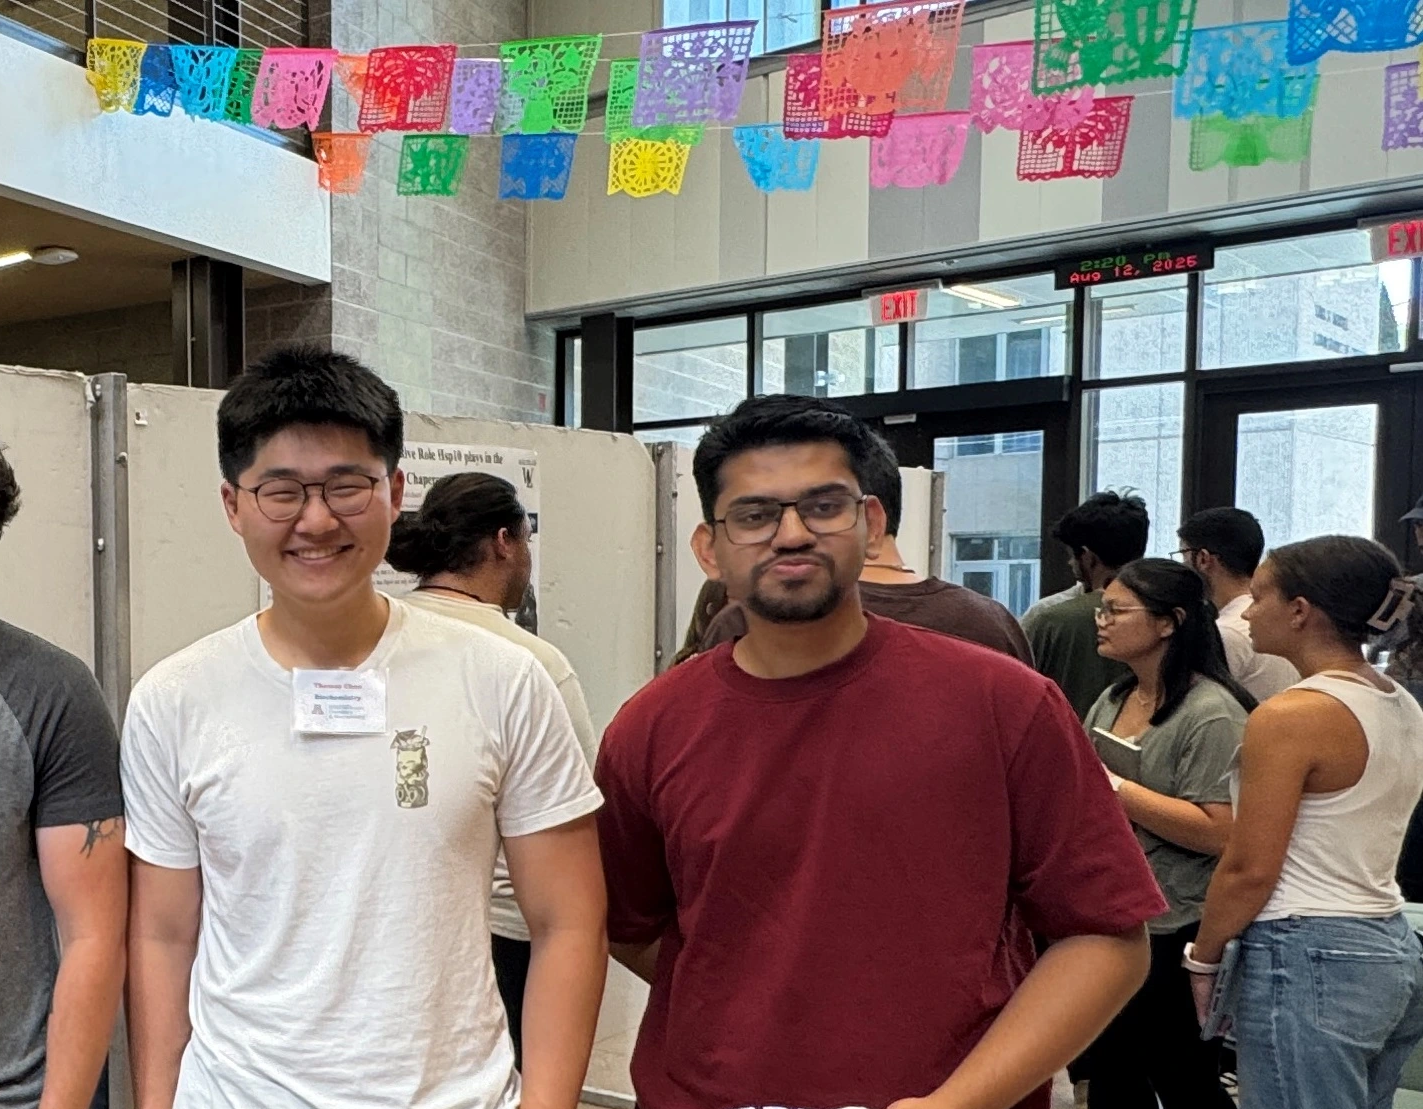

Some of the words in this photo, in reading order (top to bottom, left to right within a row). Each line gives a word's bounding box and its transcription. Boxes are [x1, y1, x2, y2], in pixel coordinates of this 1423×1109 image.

[1387, 220, 1423, 256] EXI
[1080, 254, 1127, 272] 2:20
[1070, 271, 1101, 284] Aug
[881, 289, 918, 321] EXIT
[464, 450, 483, 466] plays
[493, 452, 504, 465] the
[406, 471, 439, 487] Chaper
